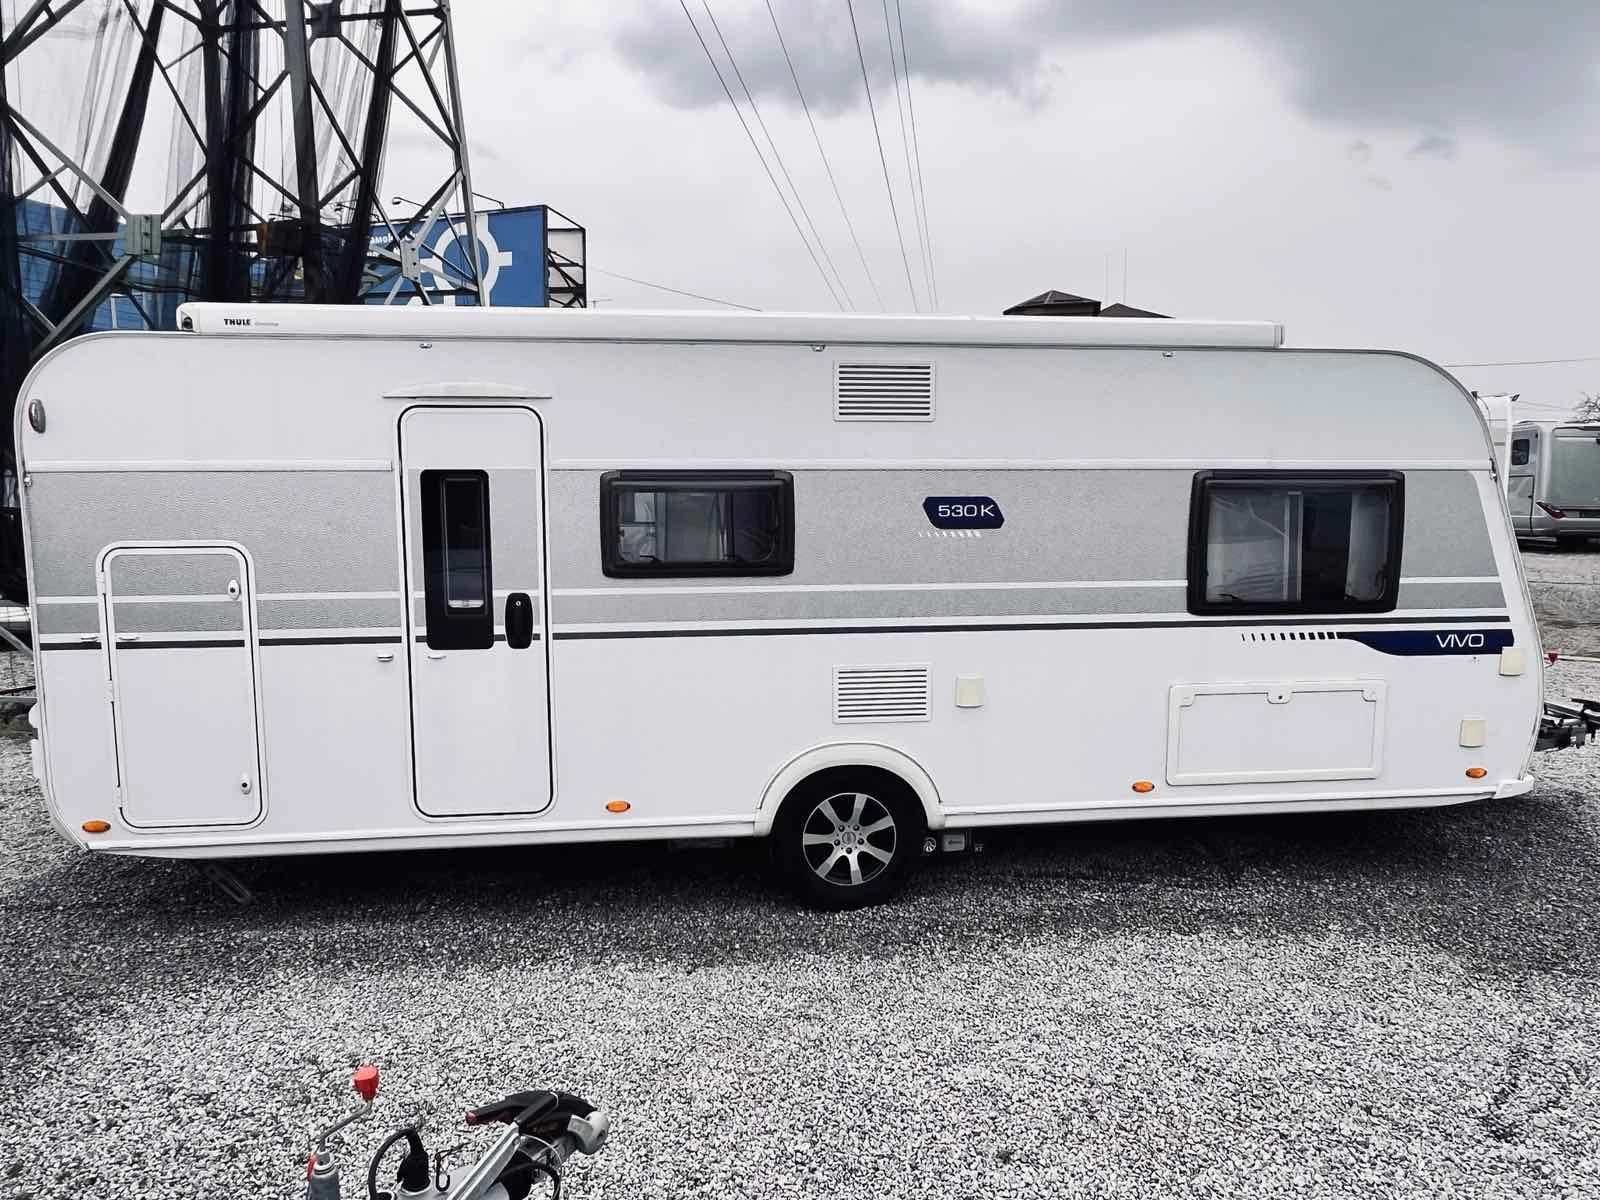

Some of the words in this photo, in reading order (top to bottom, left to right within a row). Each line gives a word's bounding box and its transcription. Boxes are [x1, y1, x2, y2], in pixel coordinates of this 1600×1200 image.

[223, 318, 251, 326] THULE
[938, 504, 978, 517] 530
[981, 504, 995, 517] K
[1436, 633, 1484, 648] VIVO
